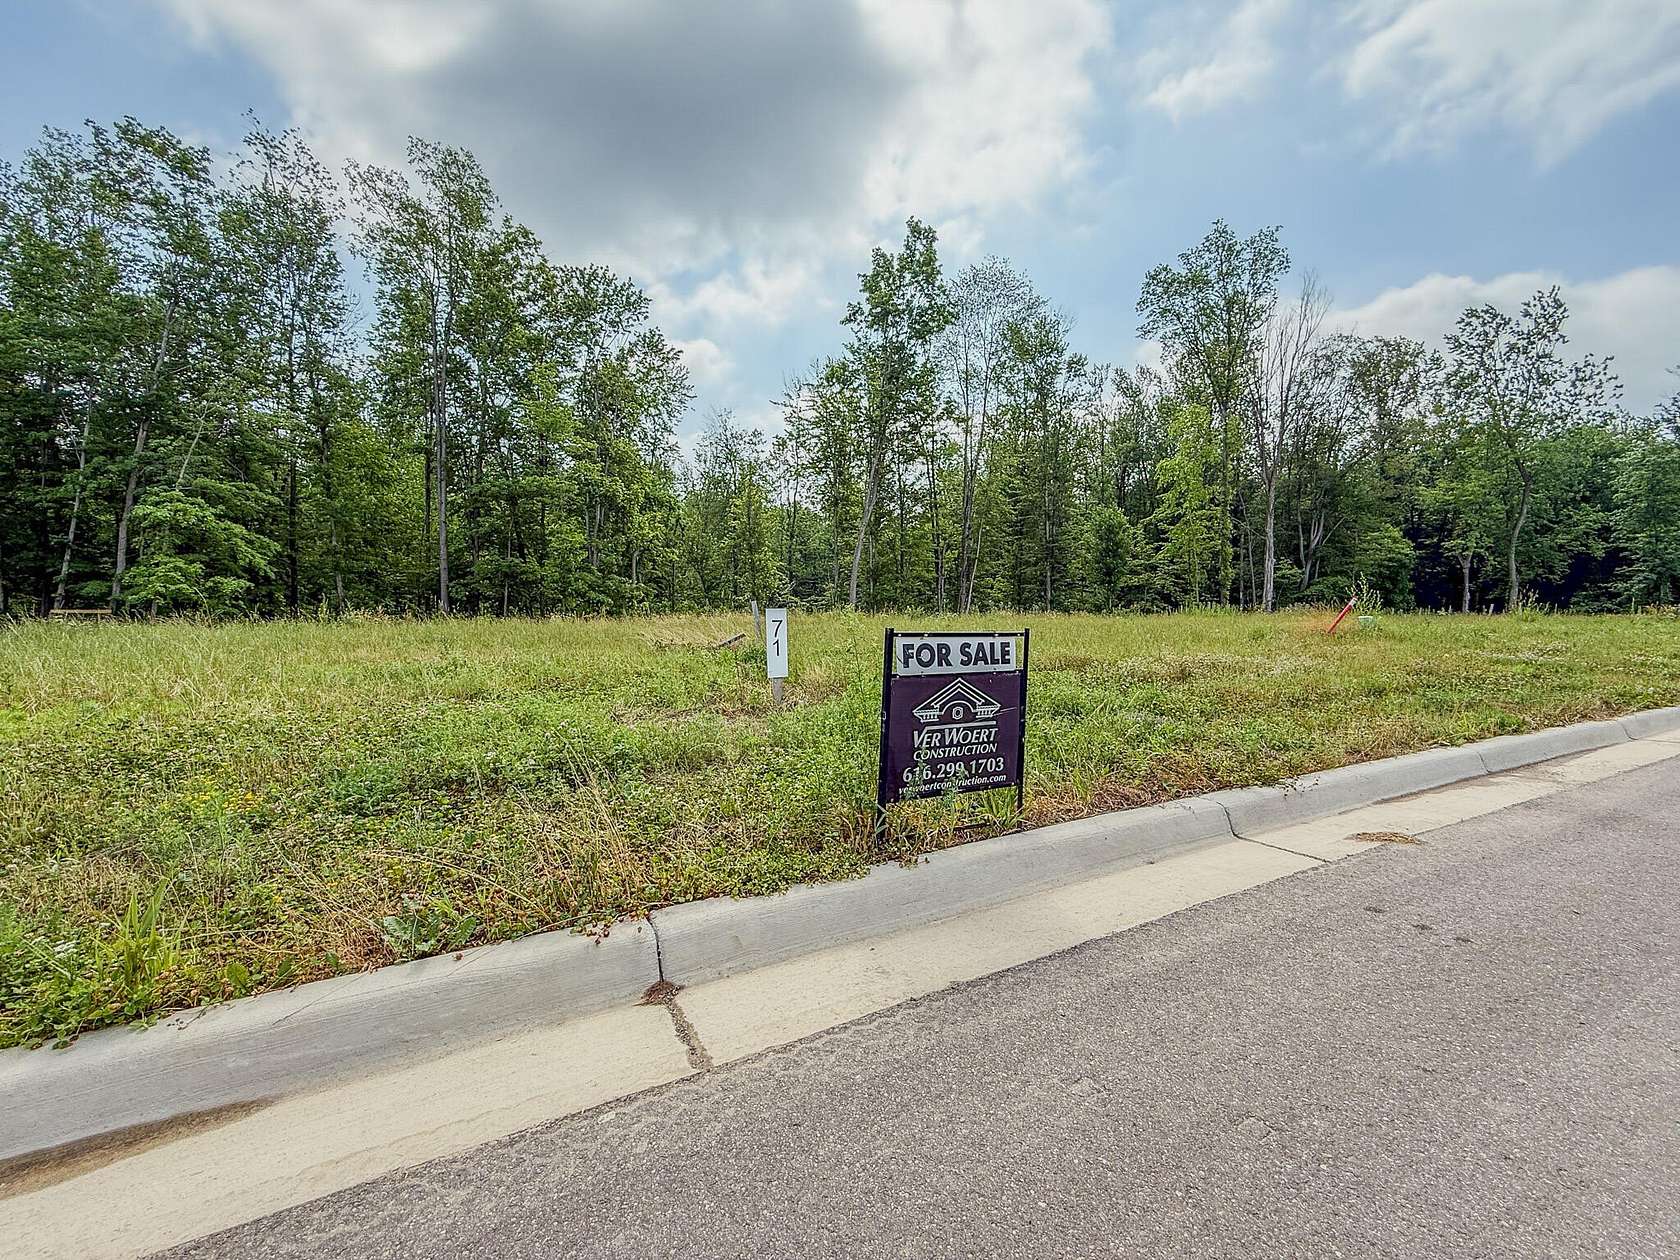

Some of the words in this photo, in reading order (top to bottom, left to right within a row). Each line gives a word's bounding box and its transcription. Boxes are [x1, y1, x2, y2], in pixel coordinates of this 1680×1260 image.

[902, 642, 952, 668] FOR
[960, 641, 1011, 666] SALE
[913, 730, 941, 748] VER
[944, 727, 998, 745] WOERT
[913, 743, 997, 761] CONSTRUCTION
